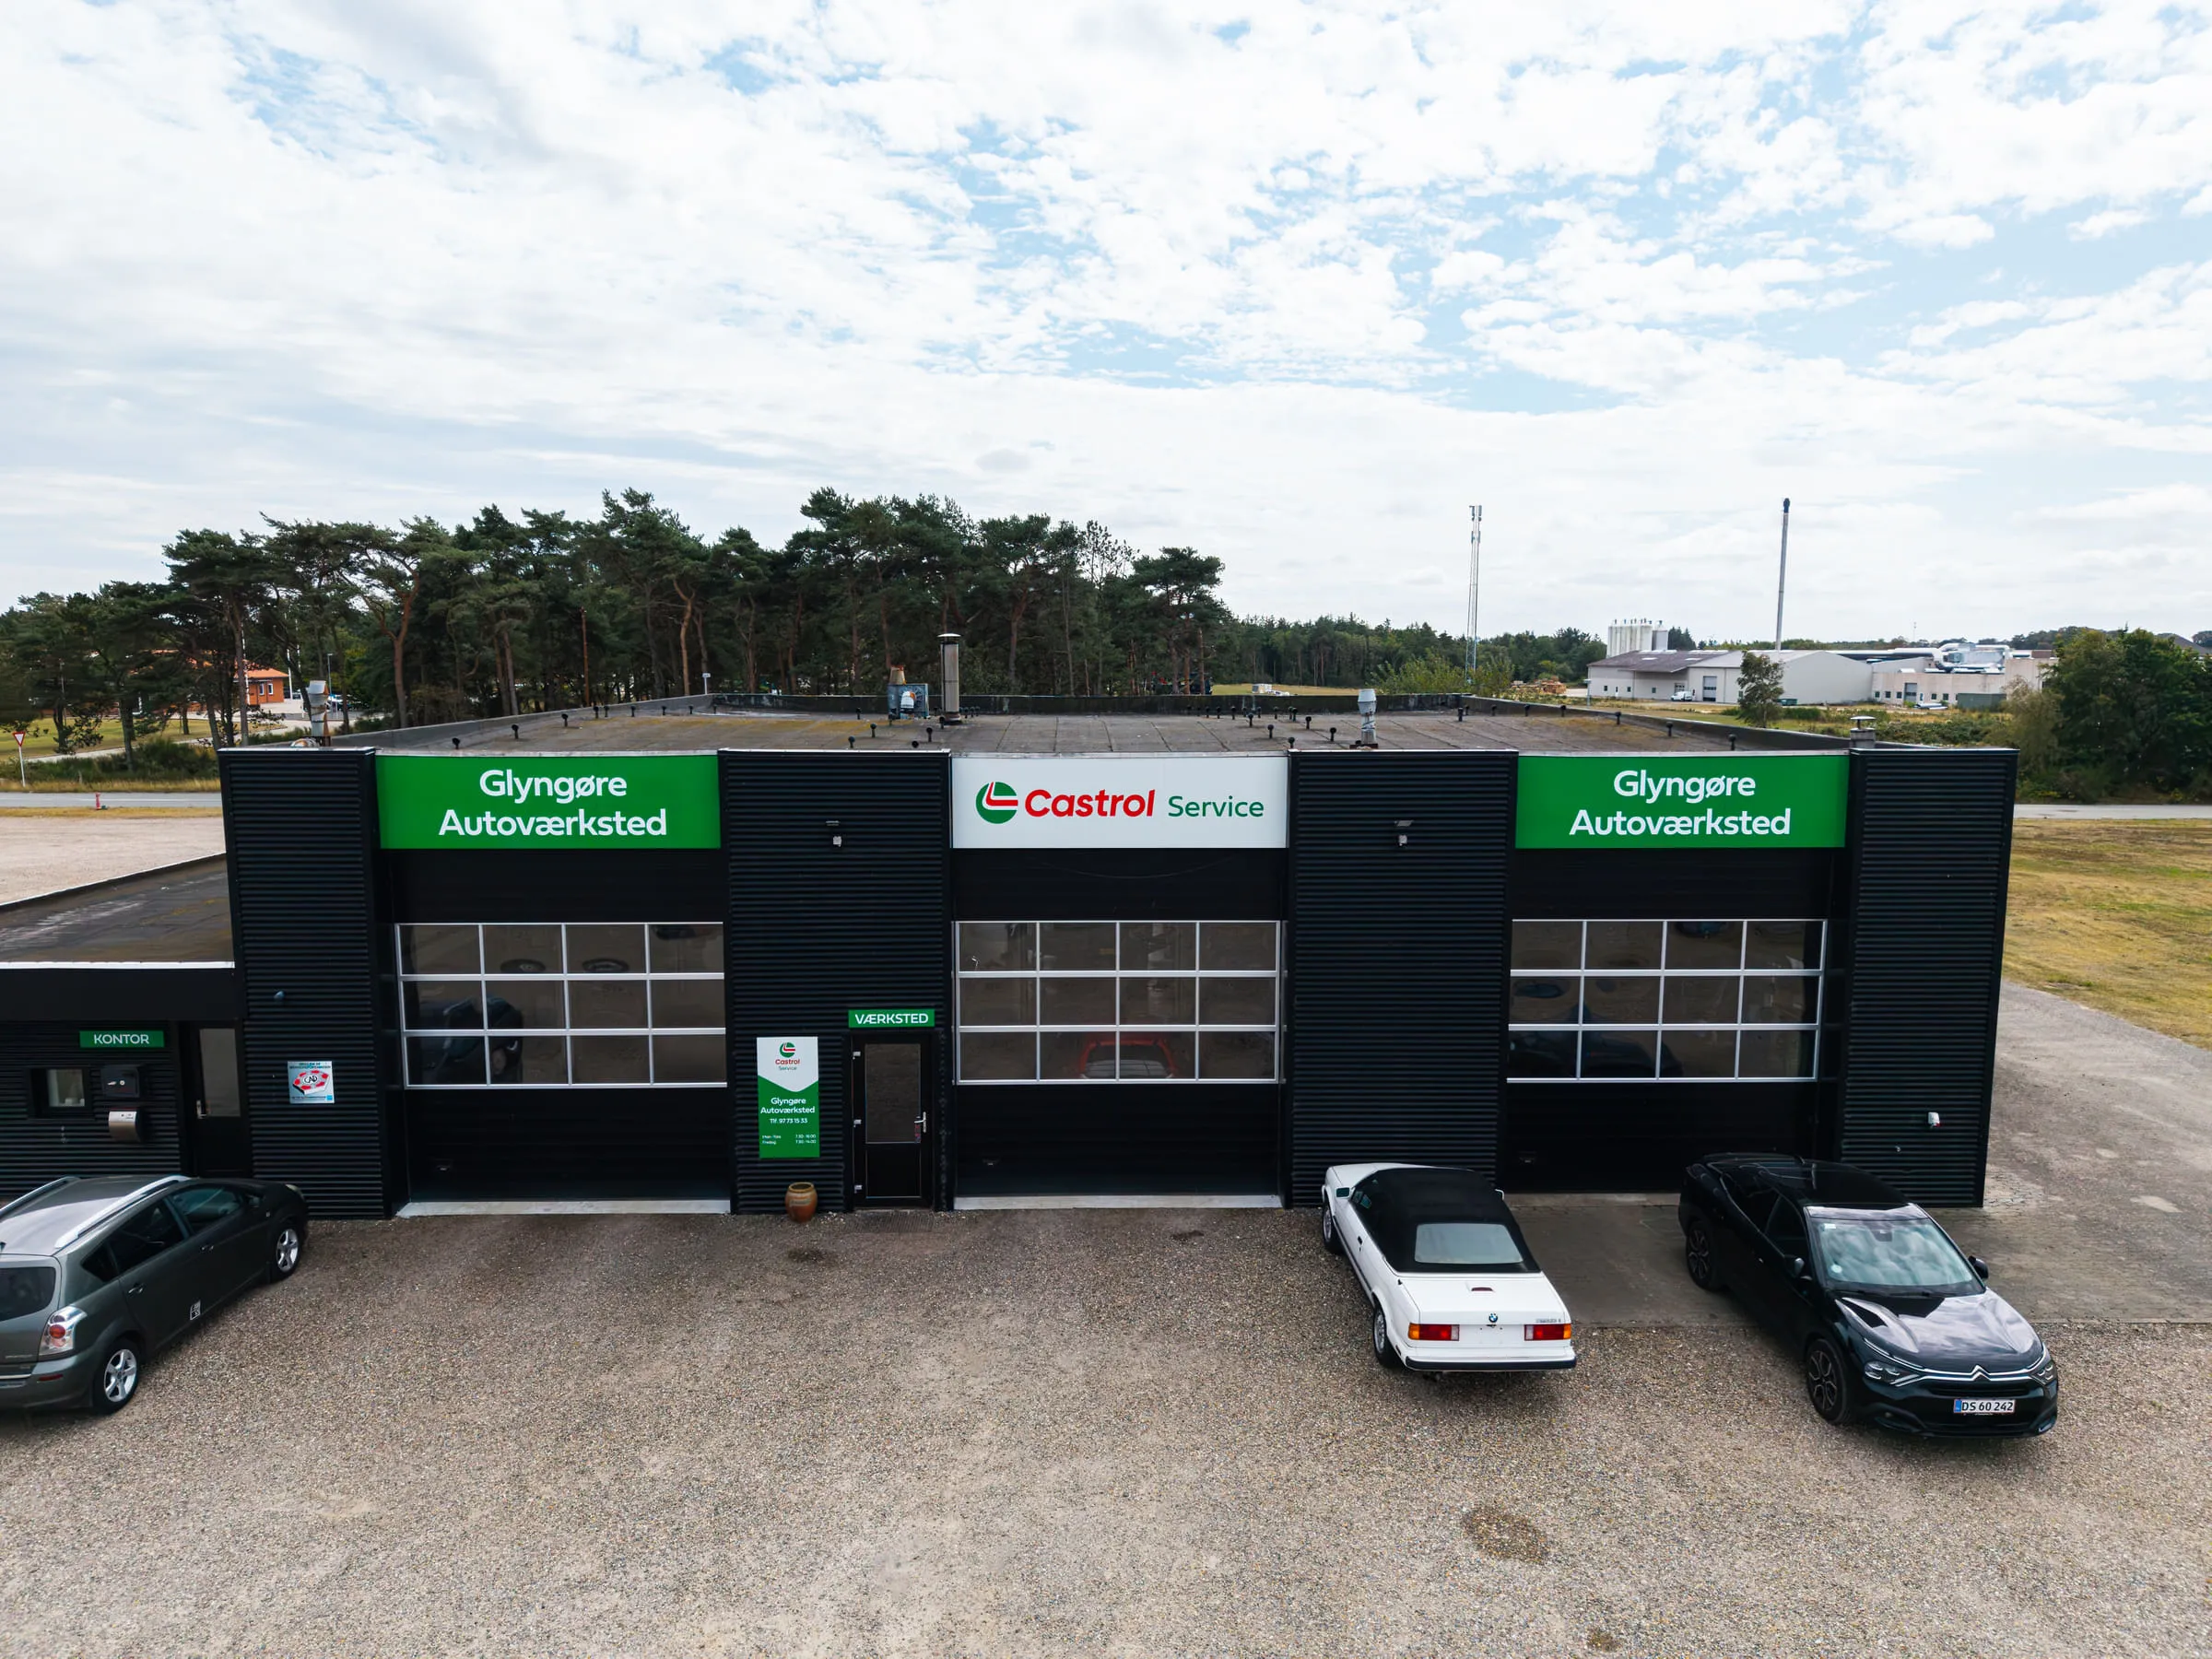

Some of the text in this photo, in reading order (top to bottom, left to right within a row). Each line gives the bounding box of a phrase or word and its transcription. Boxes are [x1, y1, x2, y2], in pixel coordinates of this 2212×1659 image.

[479, 769, 628, 805] Glyngøre
[1613, 769, 1756, 805] Glyngøre
[1025, 789, 1265, 818] Castrol Service
[438, 808, 667, 837] Autoværksted
[1569, 807, 1791, 836] Autoværksted
[854, 1013, 929, 1025] VÆRKSTED
[93, 1033, 149, 1044] KONTOR
[760, 1106, 816, 1114] Autoværksted
[771, 1097, 806, 1106] Glyngøre
[1961, 1401, 2014, 1412] DS 60 242
